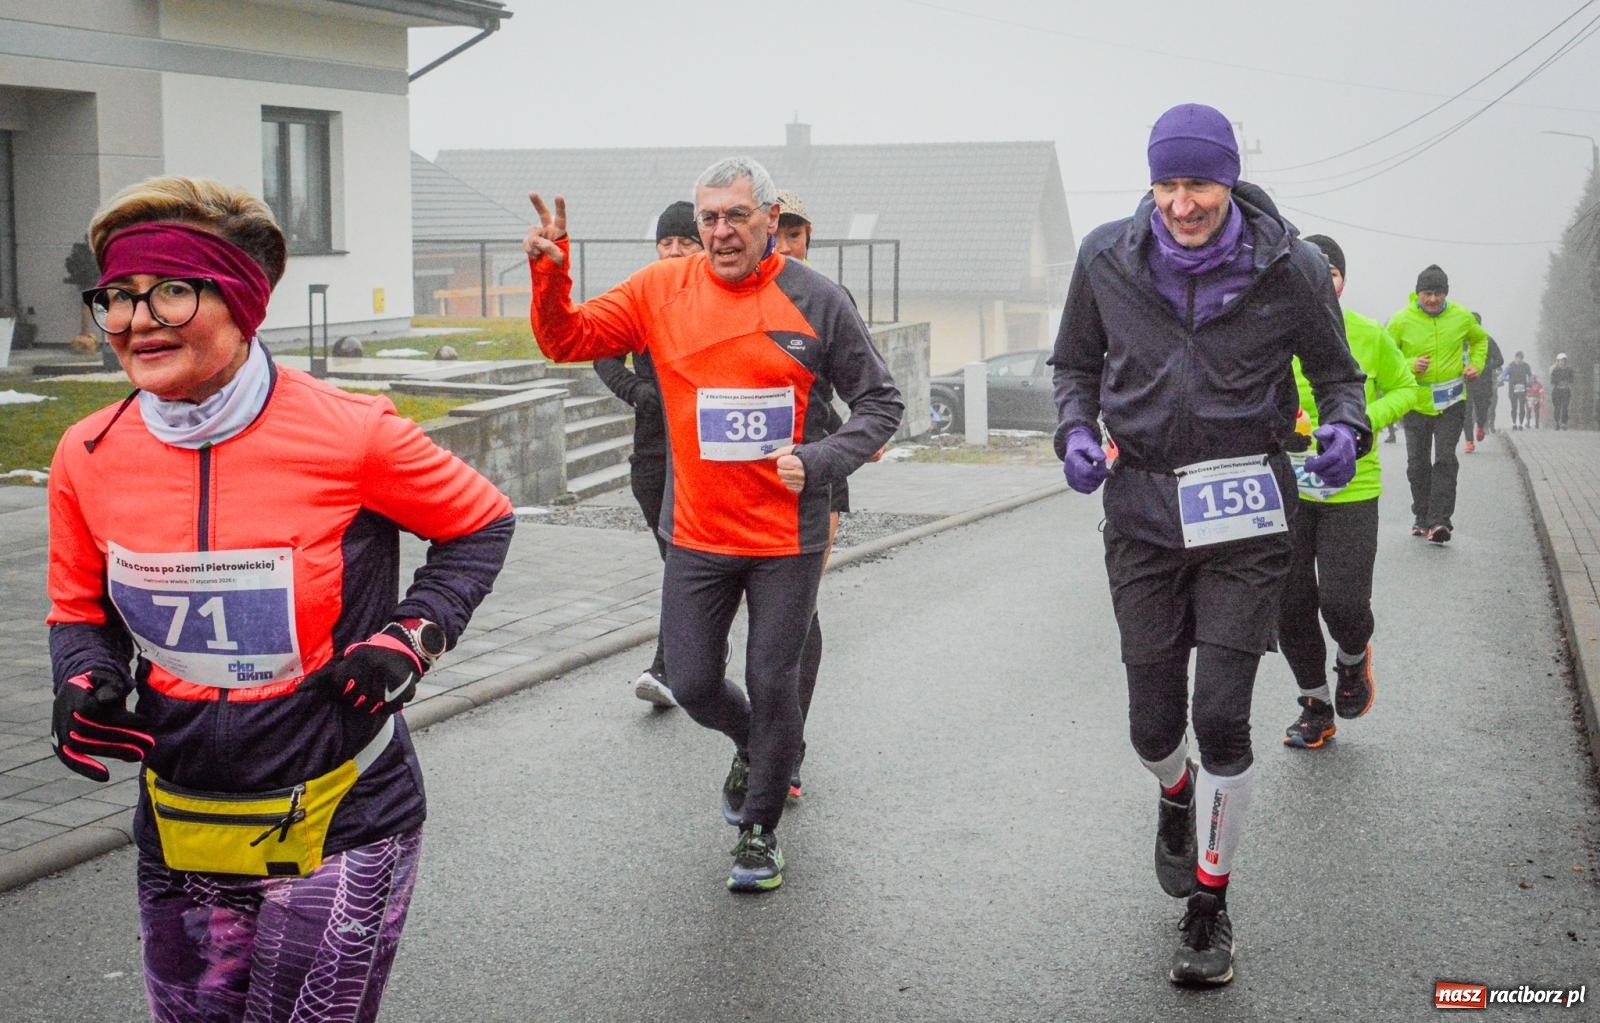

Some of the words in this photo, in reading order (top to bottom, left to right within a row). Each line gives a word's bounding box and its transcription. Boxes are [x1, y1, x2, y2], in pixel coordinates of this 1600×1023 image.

[725, 411, 768, 441] 38
[1197, 478, 1266, 519] 158
[121, 559, 134, 570] Eko
[134, 564, 161, 573] Cross
[162, 565, 175, 575] po
[175, 563, 205, 573] Ziemi
[206, 560, 275, 572] Pietrowickiej
[151, 594, 239, 650] 71
